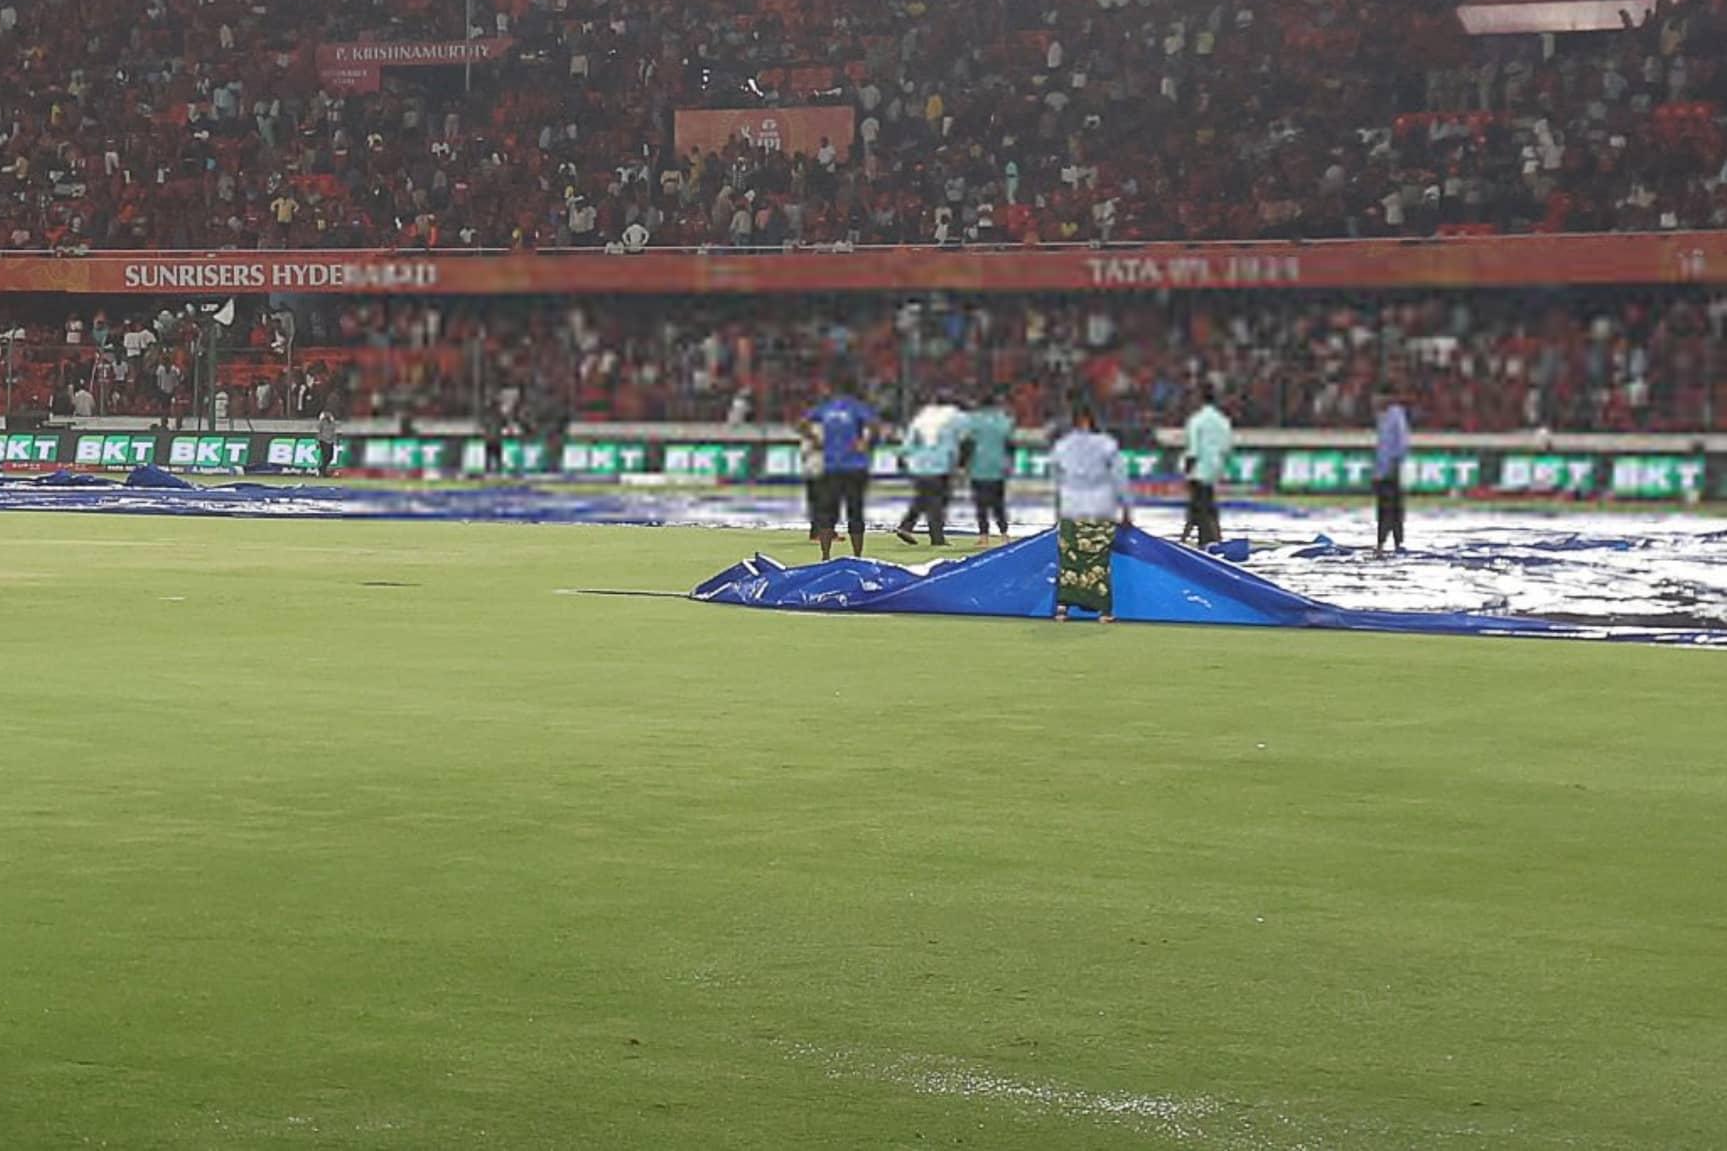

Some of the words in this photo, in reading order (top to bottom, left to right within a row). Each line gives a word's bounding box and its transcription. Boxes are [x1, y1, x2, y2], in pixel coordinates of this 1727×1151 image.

[125, 264, 265, 286] SUNRISERS
[1088, 258, 1162, 283] TATA
[75, 441, 153, 462] BKT
[169, 442, 247, 463] BKT
[268, 444, 344, 465] BKT
[1401, 459, 1479, 484] KT
